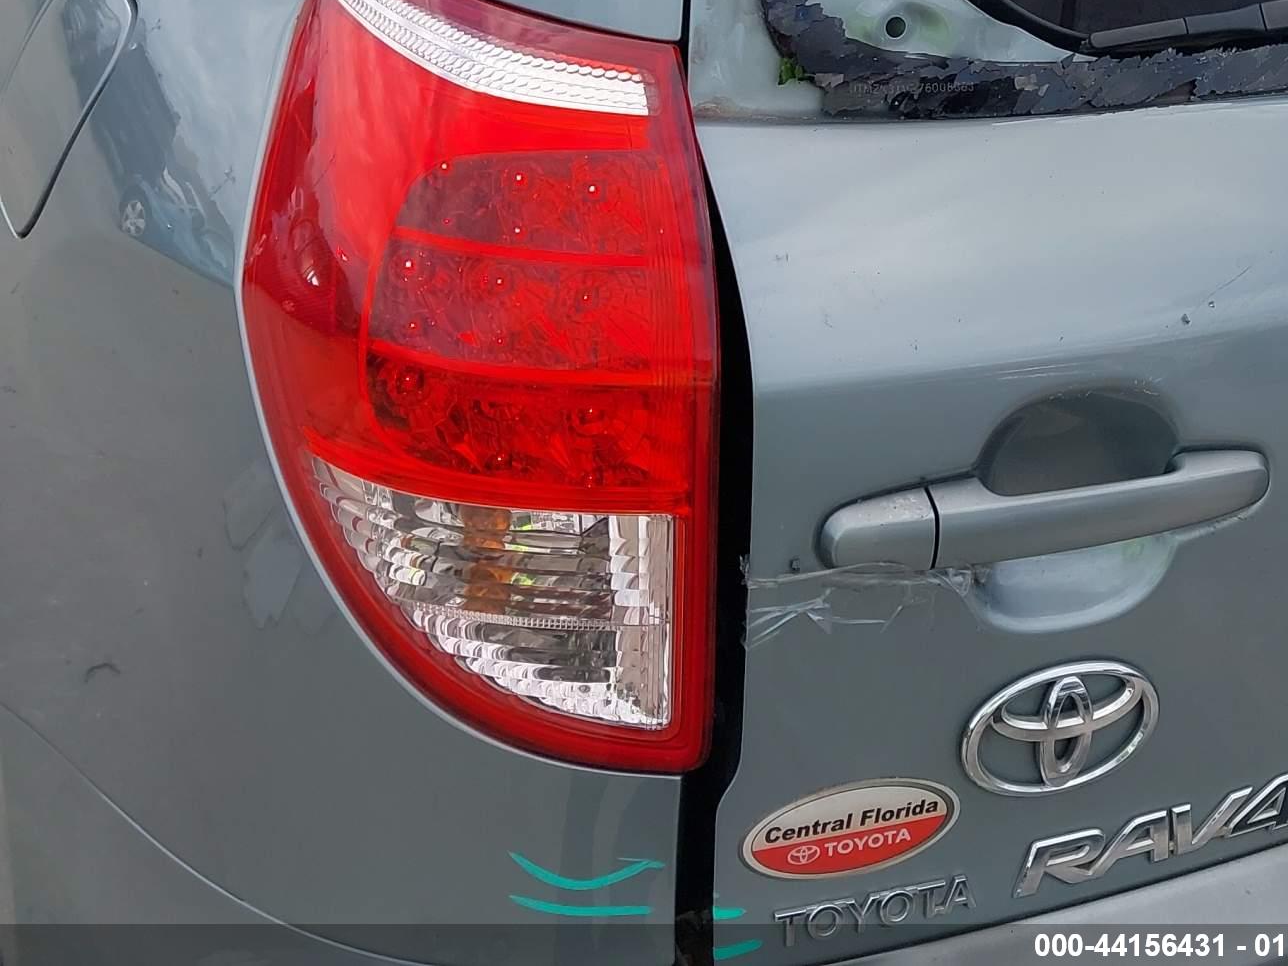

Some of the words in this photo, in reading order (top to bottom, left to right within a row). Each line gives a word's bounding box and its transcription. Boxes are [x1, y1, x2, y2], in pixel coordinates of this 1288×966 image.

[765, 813, 853, 844] Central
[859, 799, 939, 827] Florida
[824, 828, 912, 857] TOYOTA
[773, 874, 977, 948] TOYOTA
